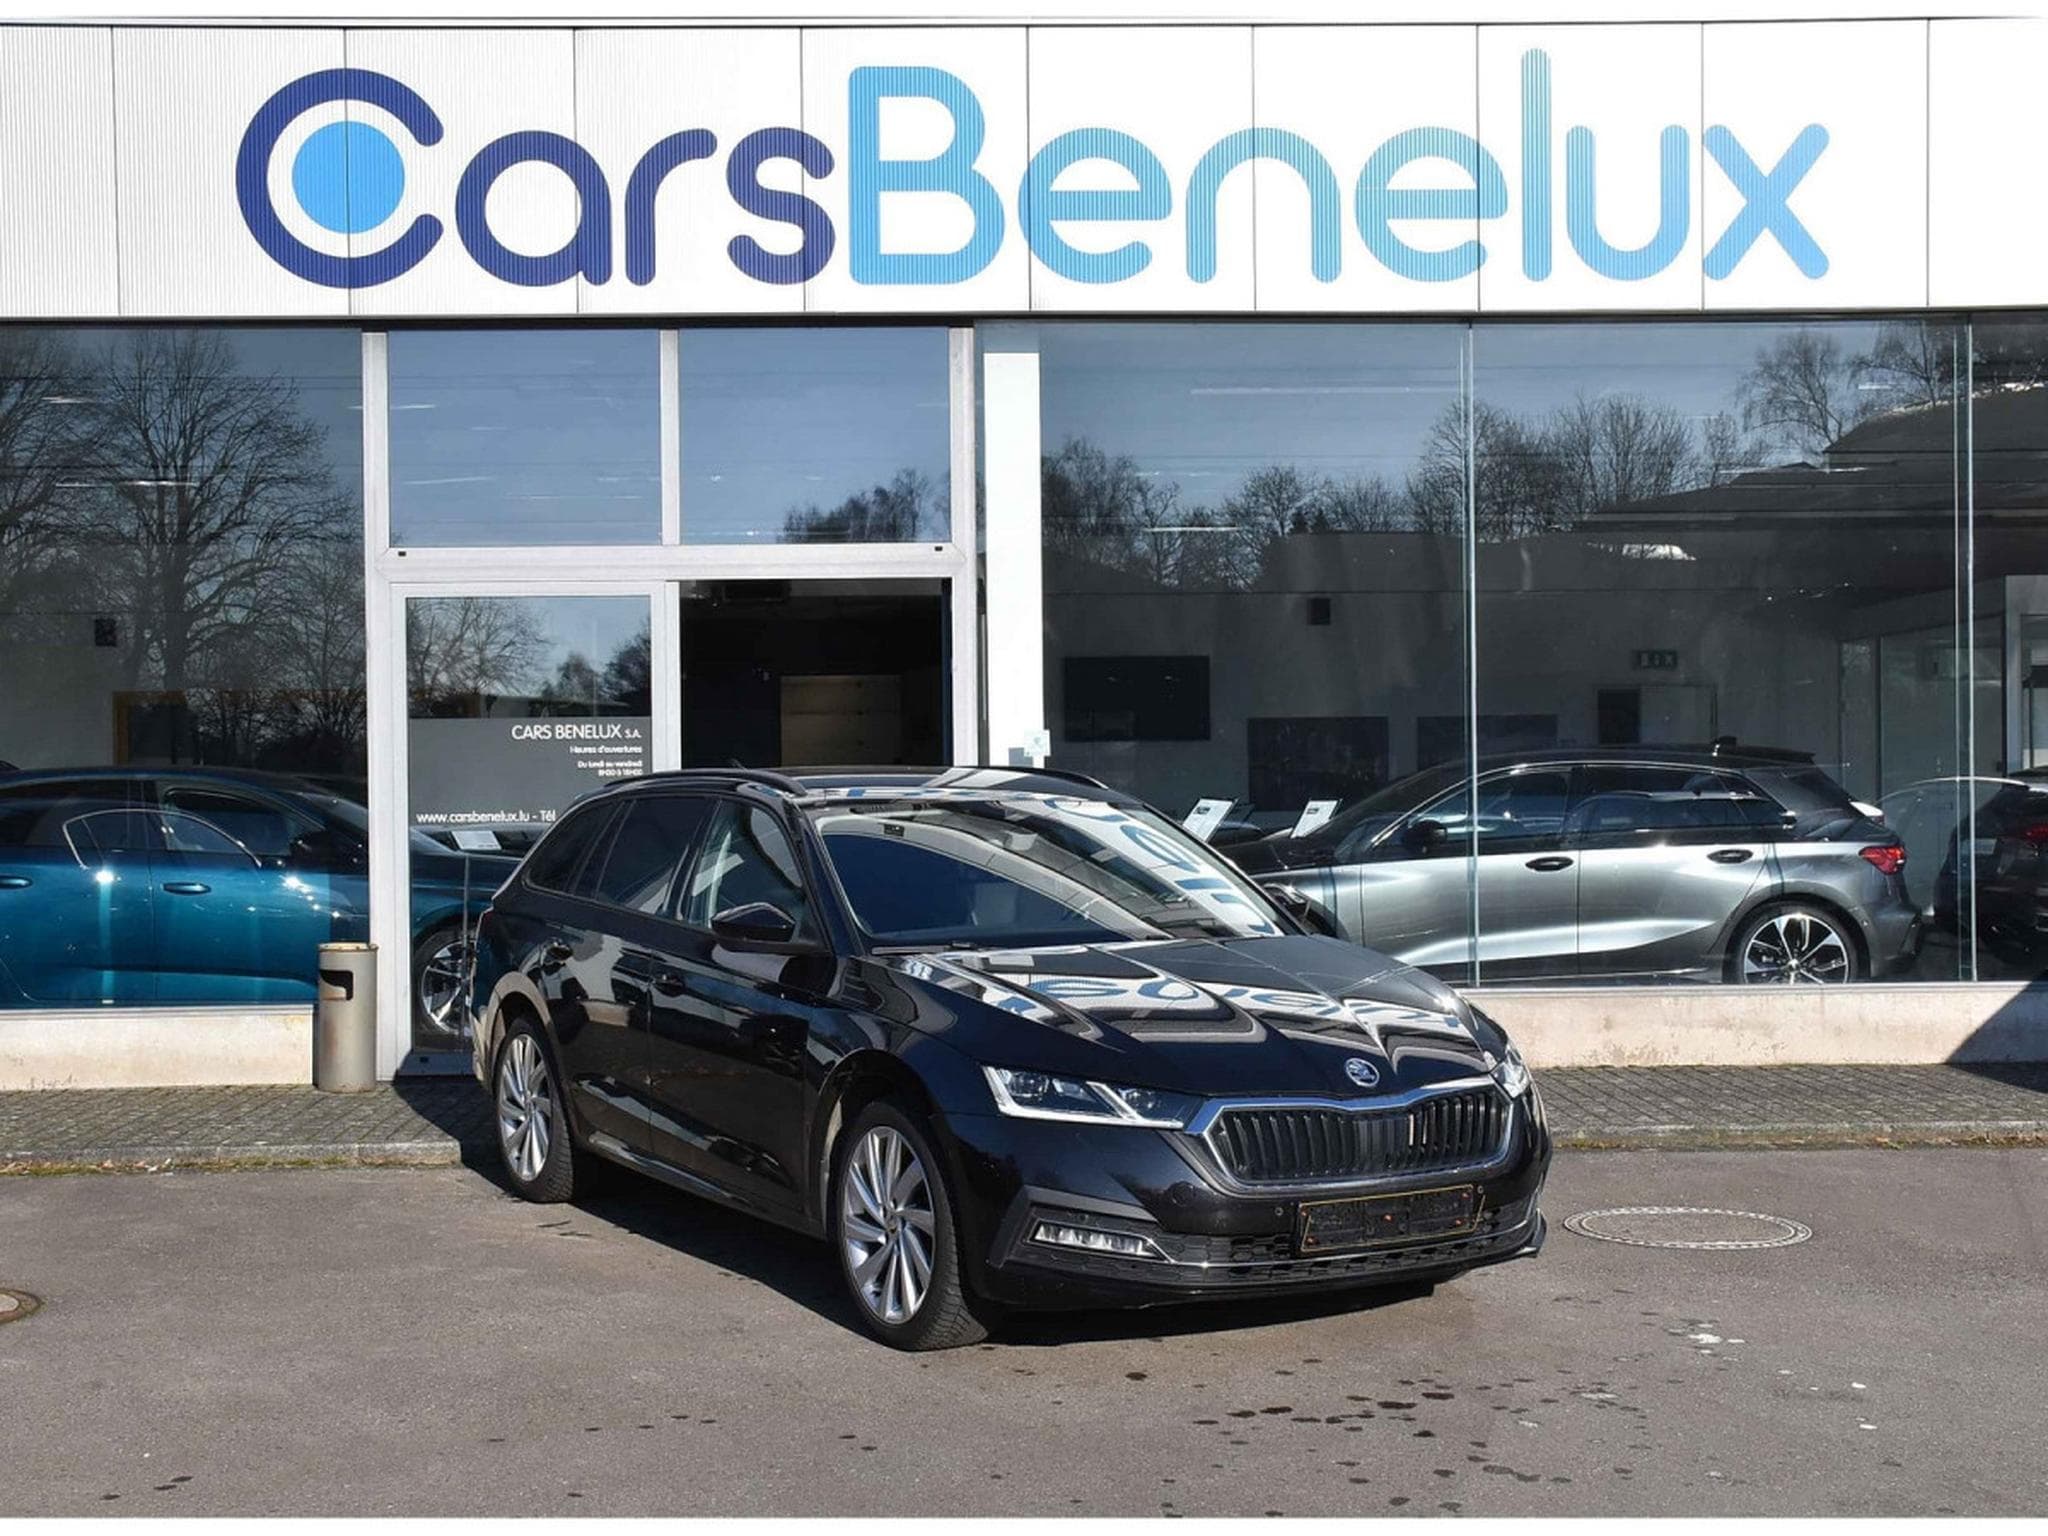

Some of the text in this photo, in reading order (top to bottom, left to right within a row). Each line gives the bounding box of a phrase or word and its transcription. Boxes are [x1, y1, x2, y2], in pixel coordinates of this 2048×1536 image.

[511, 725, 552, 740] CARS
[555, 724, 622, 739] BENELUX
[416, 810, 530, 822] www.carsbenelux.lu
